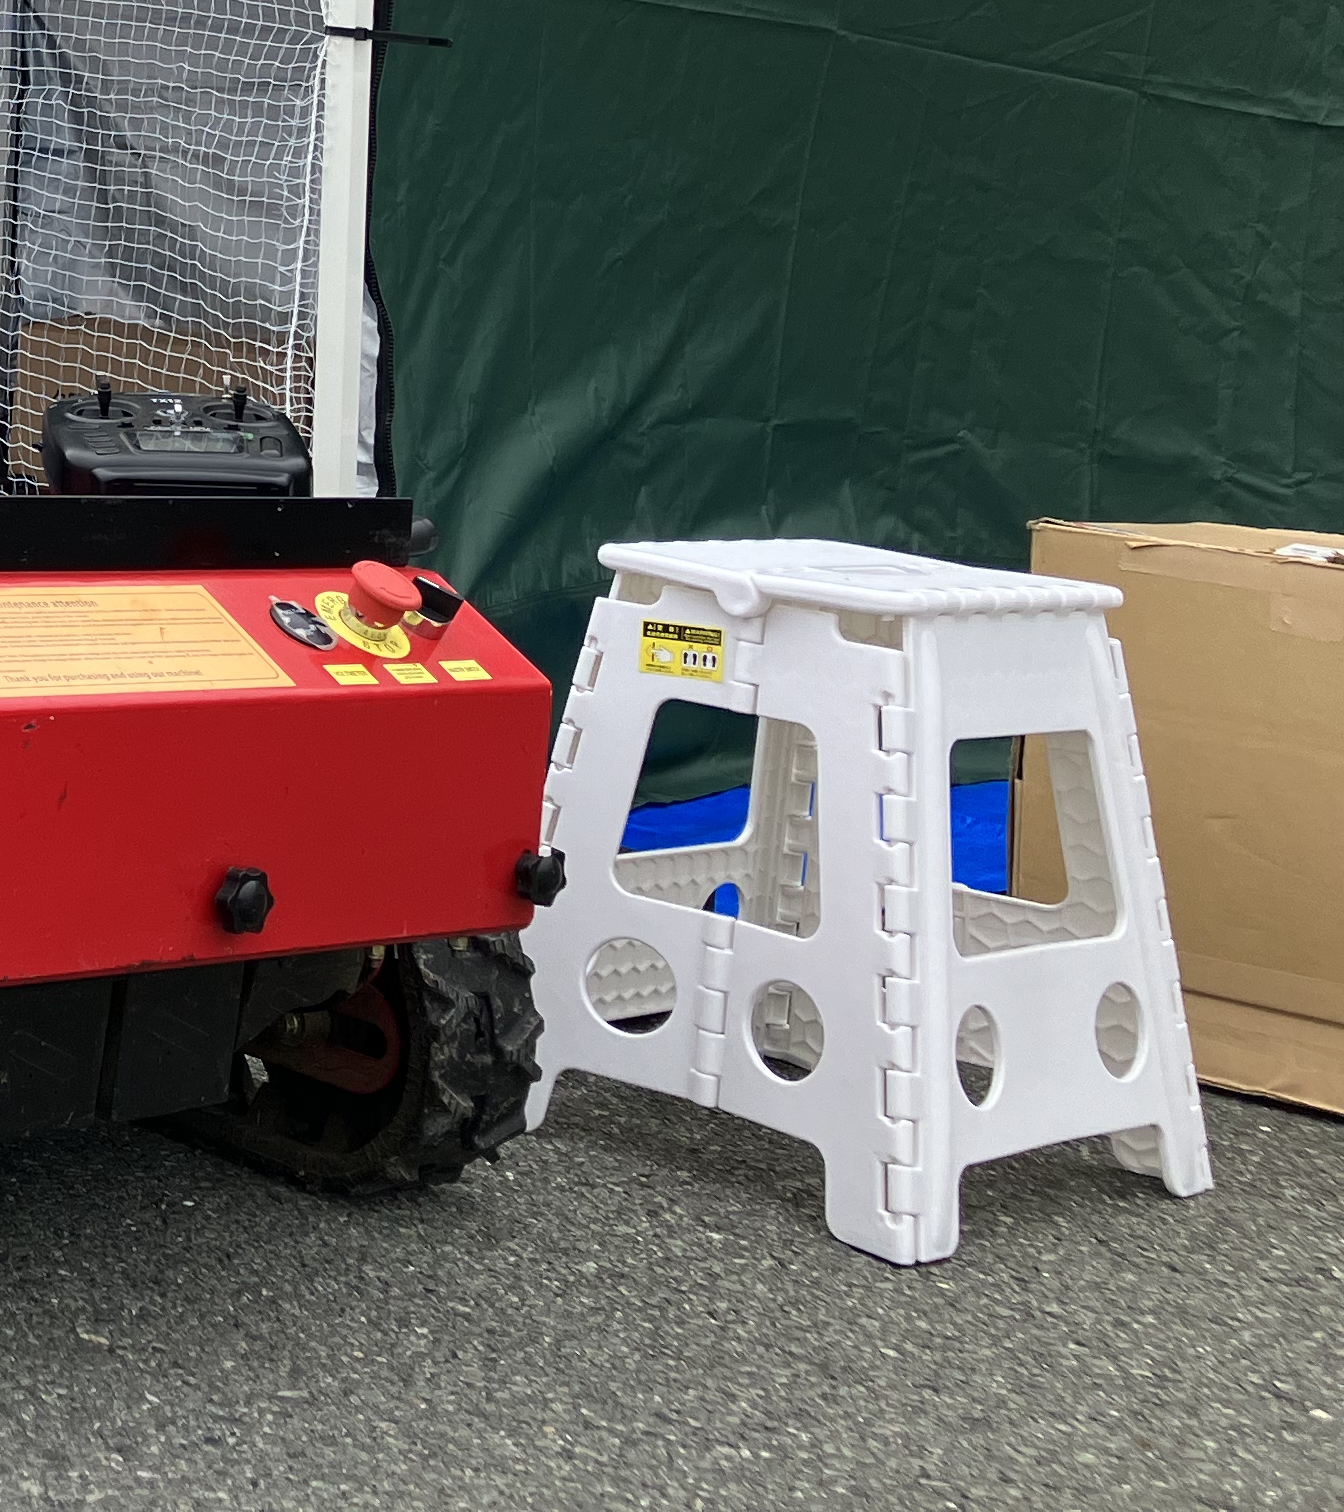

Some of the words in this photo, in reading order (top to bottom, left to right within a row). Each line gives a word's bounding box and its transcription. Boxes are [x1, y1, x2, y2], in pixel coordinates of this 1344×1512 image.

[51, 598, 99, 609] attention
[32, 675, 48, 684] you
[49, 673, 62, 683] for
[111, 671, 125, 680] and
